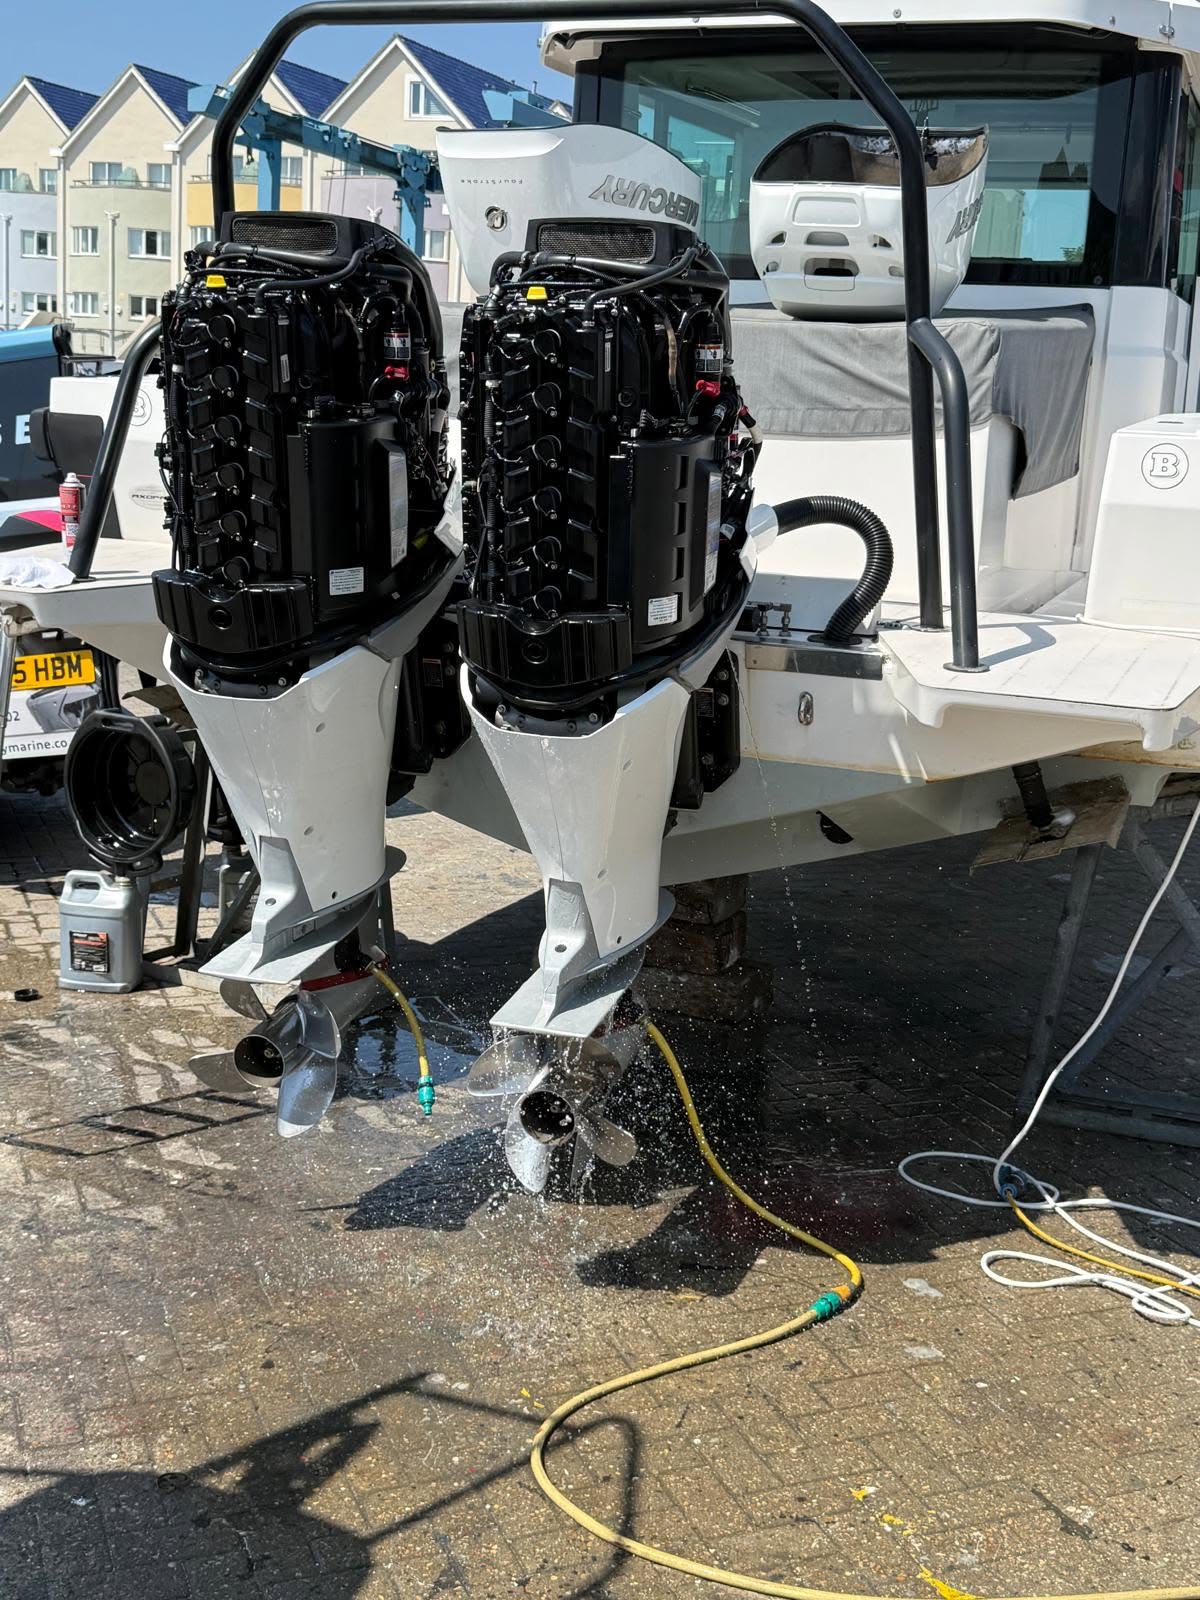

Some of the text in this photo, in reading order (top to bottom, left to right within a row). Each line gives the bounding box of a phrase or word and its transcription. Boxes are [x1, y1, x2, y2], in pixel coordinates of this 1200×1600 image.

[589, 175, 700, 226] MERCURY
[1150, 453, 1179, 478] B
[34, 654, 82, 681] HBM
